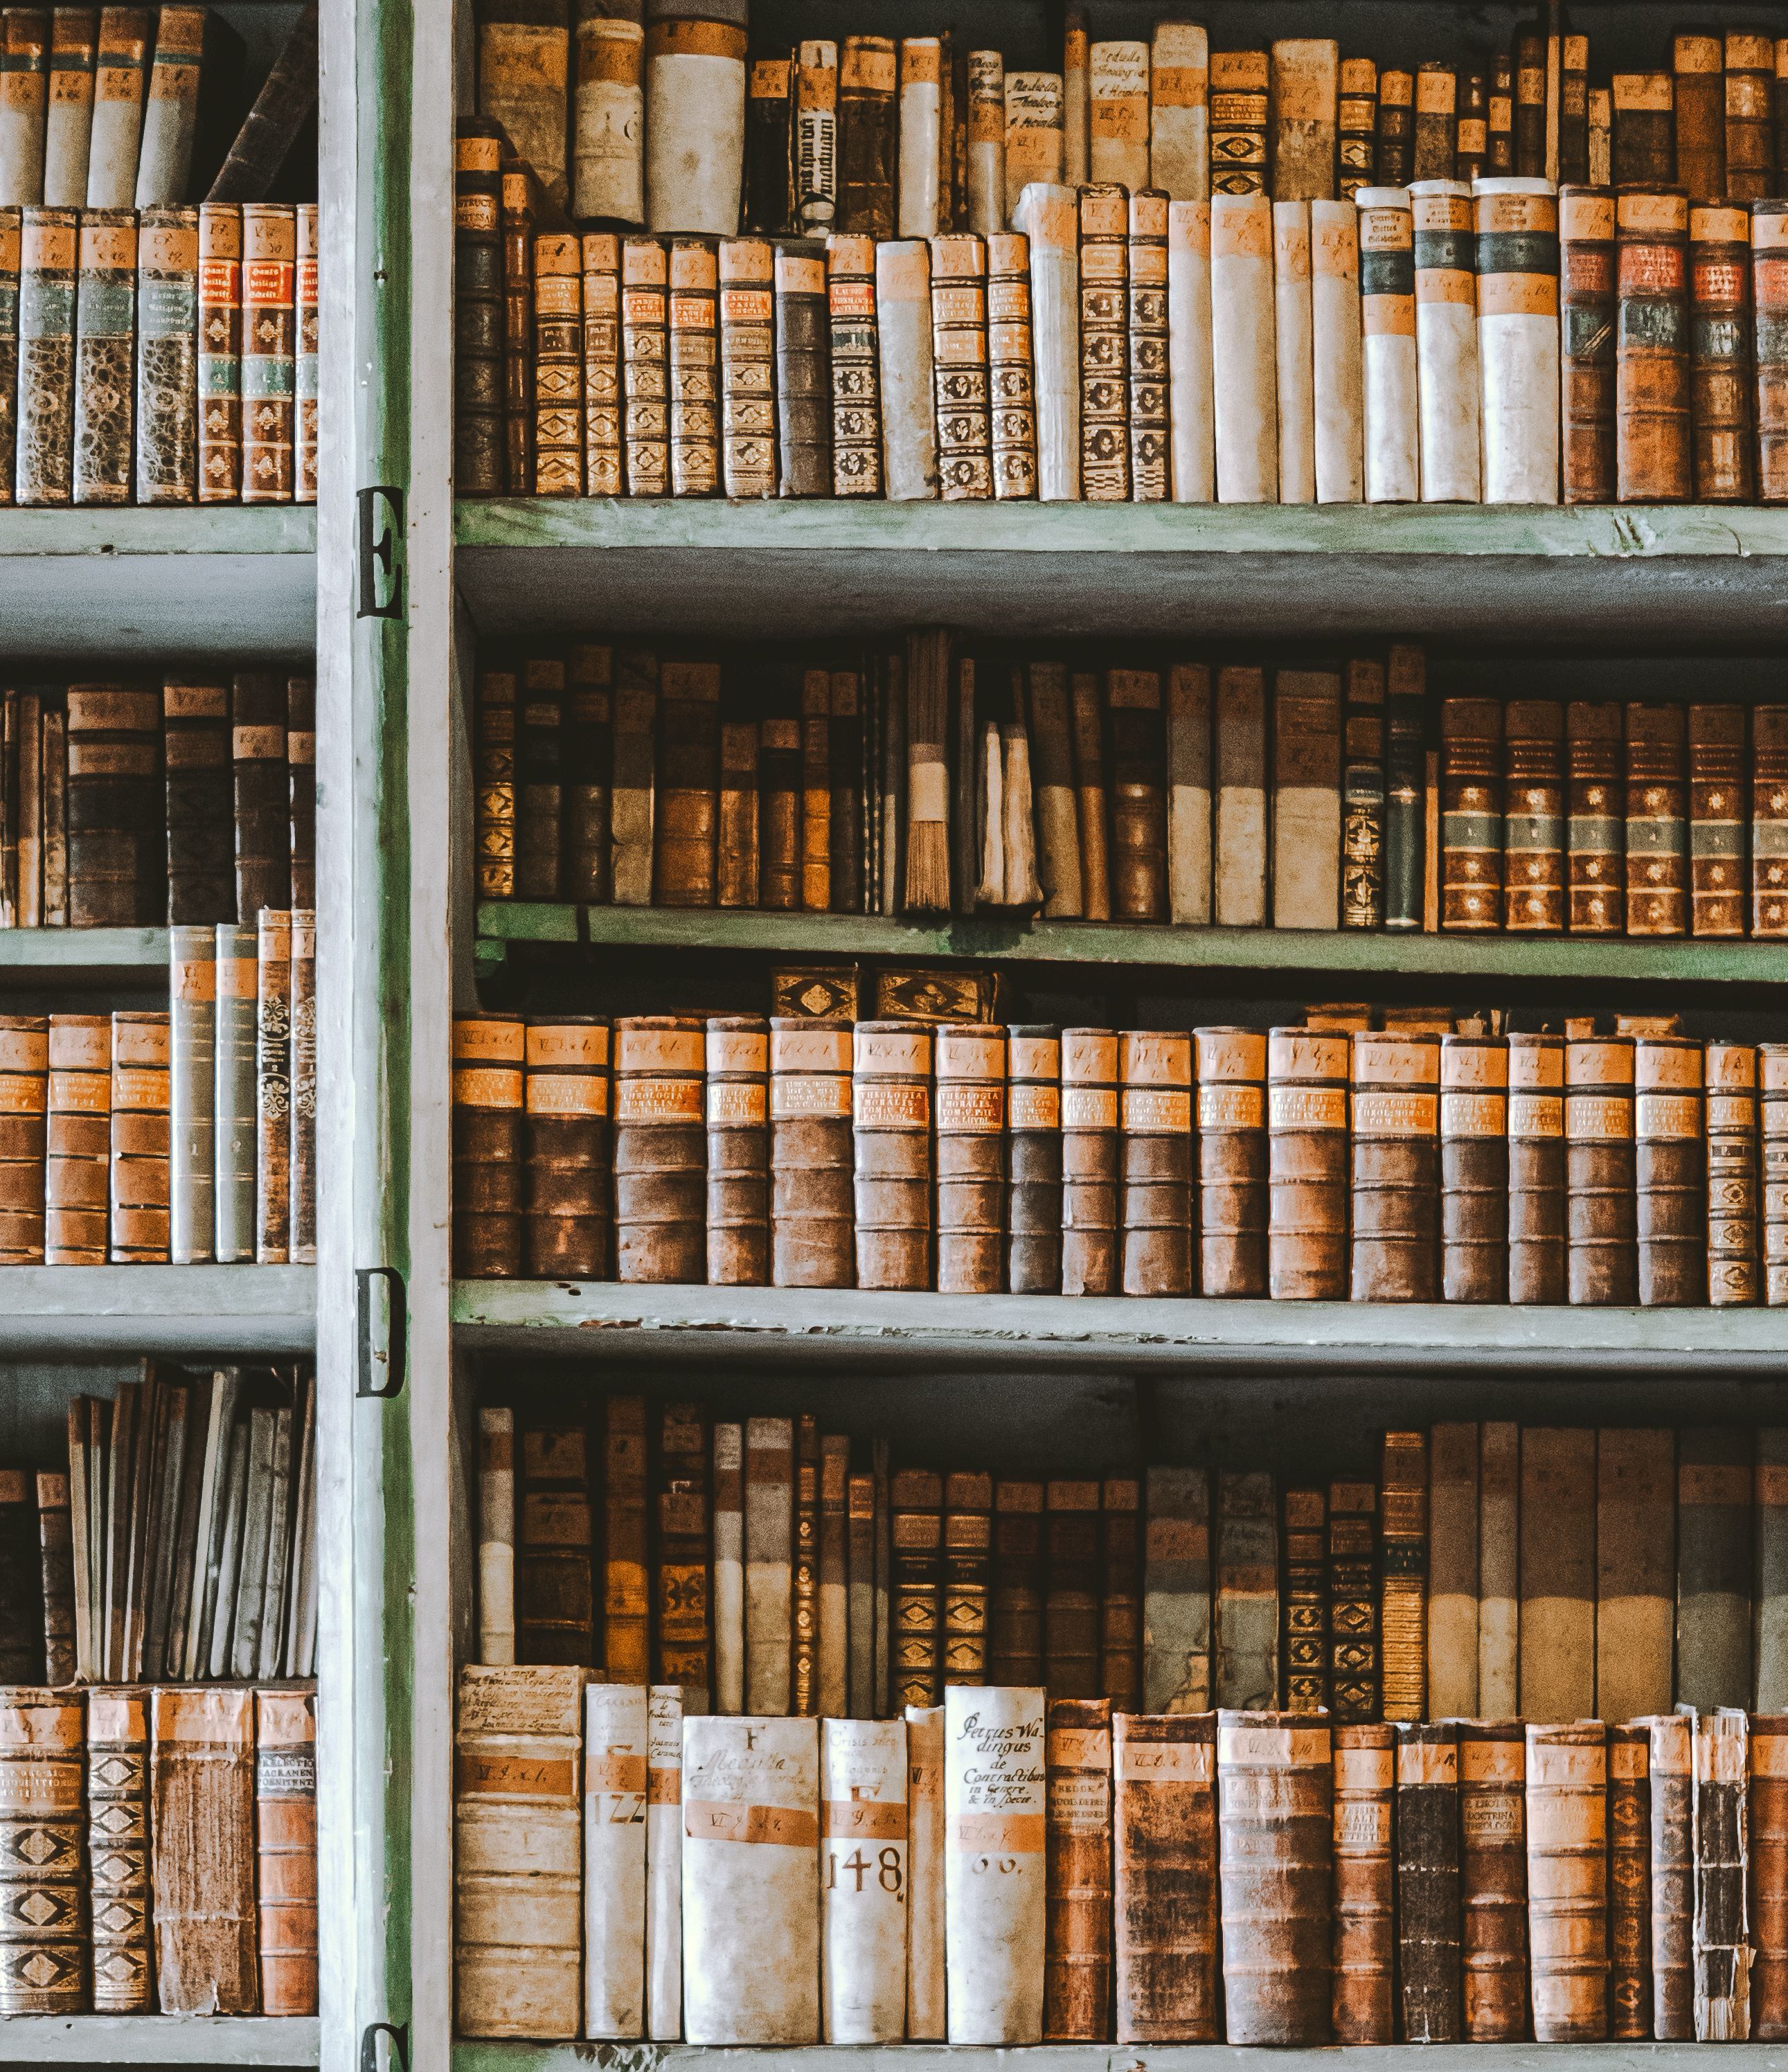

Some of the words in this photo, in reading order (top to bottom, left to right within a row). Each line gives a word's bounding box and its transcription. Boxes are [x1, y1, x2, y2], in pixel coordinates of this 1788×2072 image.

[357, 485, 404, 619] E
[860, 1091, 922, 1100] THEOLOGIA
[355, 1267, 407, 1399] D
[957, 1712, 1013, 1740] Petrus
[976, 1735, 1031, 1755] dingus
[990, 1754, 1007, 1769] de
[963, 1767, 1046, 1785] Contractibus
[969, 1785, 982, 1794] in
